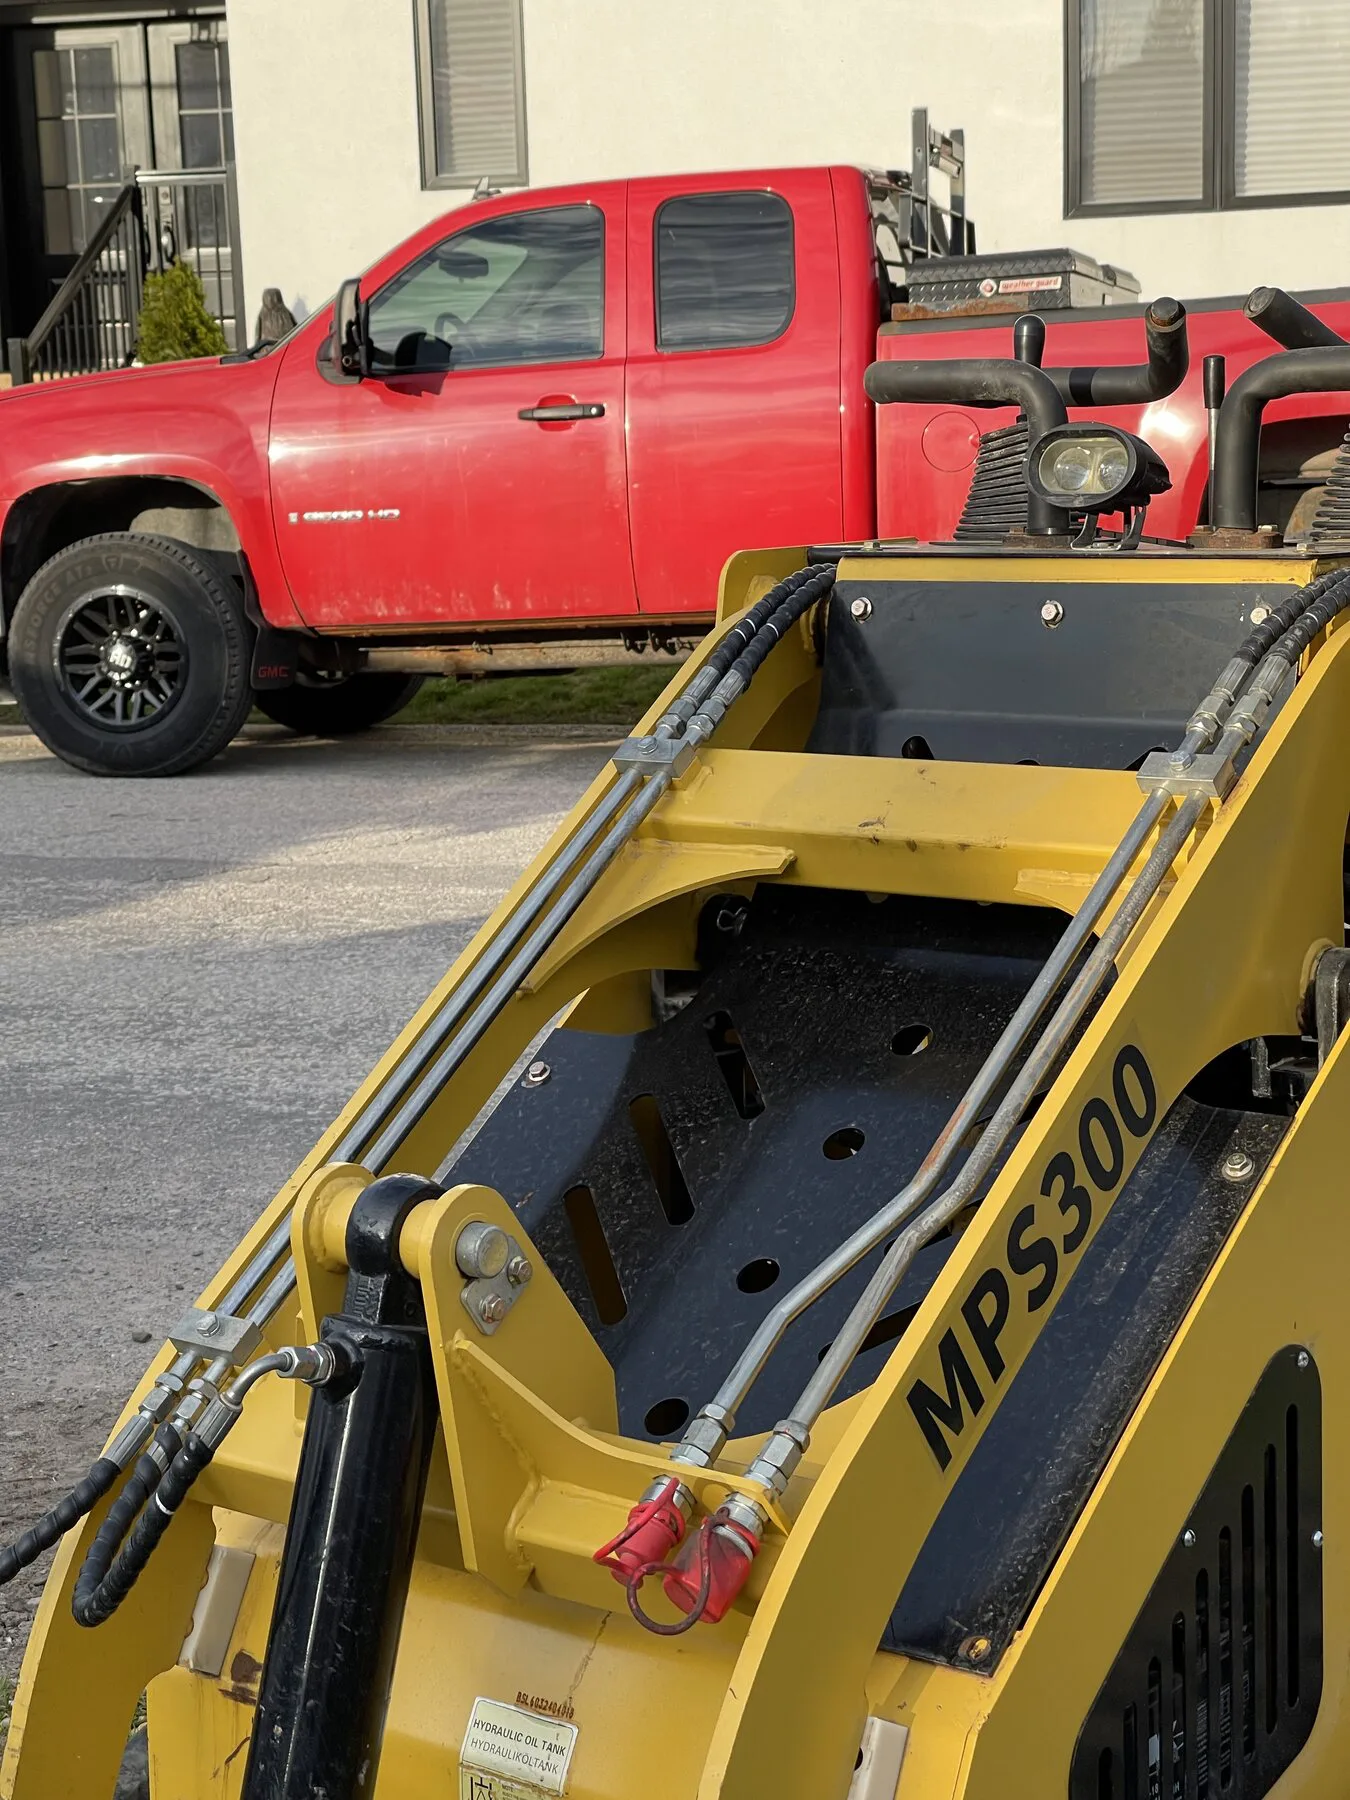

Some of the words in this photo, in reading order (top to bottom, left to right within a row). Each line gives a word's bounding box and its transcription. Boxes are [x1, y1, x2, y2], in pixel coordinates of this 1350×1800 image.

[258, 666, 291, 678] GMC
[906, 1044, 1157, 1473] MPS300
[473, 1719, 524, 1742] HYDRAULIC
[524, 1735, 538, 1748] OIL
[542, 1740, 567, 1757] TANK
